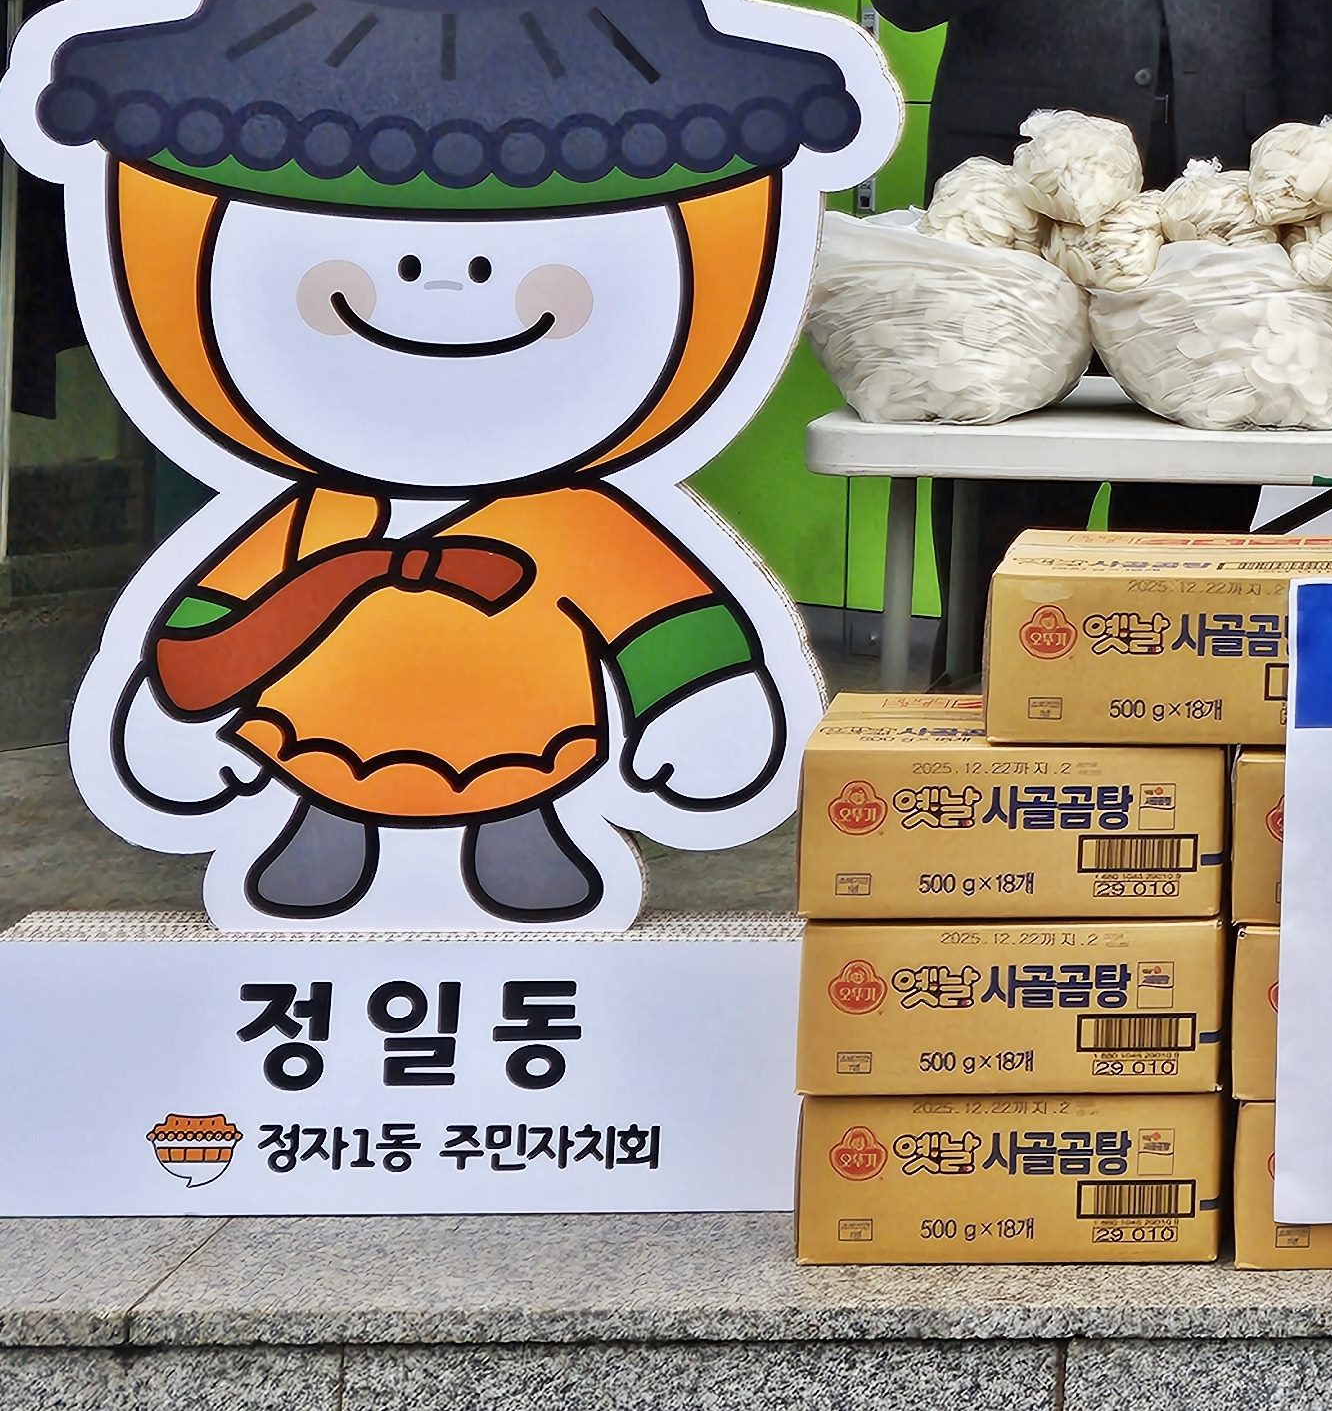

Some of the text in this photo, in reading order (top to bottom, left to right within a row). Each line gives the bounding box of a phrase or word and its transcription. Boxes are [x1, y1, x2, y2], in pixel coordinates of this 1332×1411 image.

[1083, 612, 1171, 656] 옛날
[1172, 613, 1289, 657] 사골곰
[1109, 699, 1146, 719] 500
[892, 784, 982, 829] 옛날
[983, 784, 1134, 830] 사골곰탕
[918, 873, 956, 894] 500
[1095, 881, 1176, 897] 29 010
[891, 964, 980, 1009] 옛날
[981, 964, 1131, 1010] 사골곰탕
[239, 980, 583, 1091] 정일동
[918, 1052, 956, 1073] 500
[1095, 1060, 1175, 1075] 29 010
[257, 1124, 660, 1173] 정자1동 주민자치회
[892, 1131, 981, 1175] 옛날
[982, 1130, 1131, 1175] 사골곰탕
[919, 1220, 957, 1240] 500
[1095, 1227, 1175, 1242] 29 010
